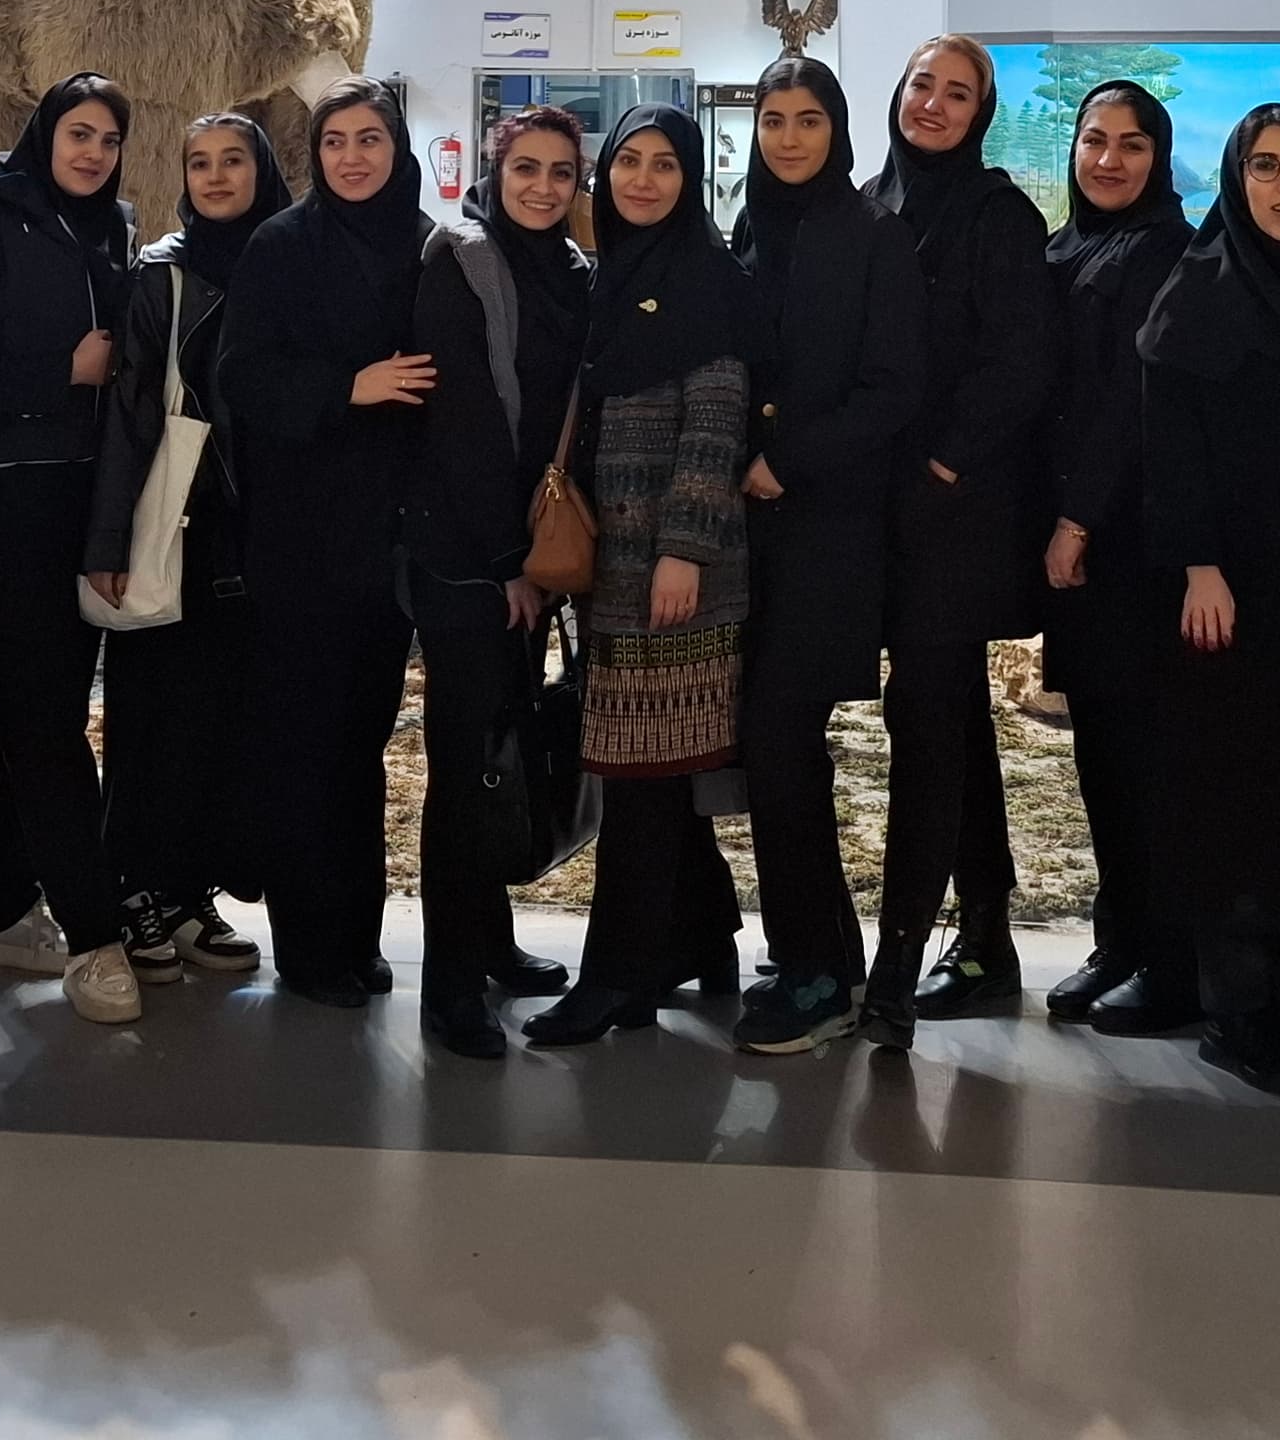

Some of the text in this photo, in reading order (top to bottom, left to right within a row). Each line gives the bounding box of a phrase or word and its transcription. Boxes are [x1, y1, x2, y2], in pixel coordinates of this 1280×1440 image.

[524, 30, 541, 40] موزه
[625, 28, 669, 39] موزه برق
[734, 90, 756, 99] Bird
